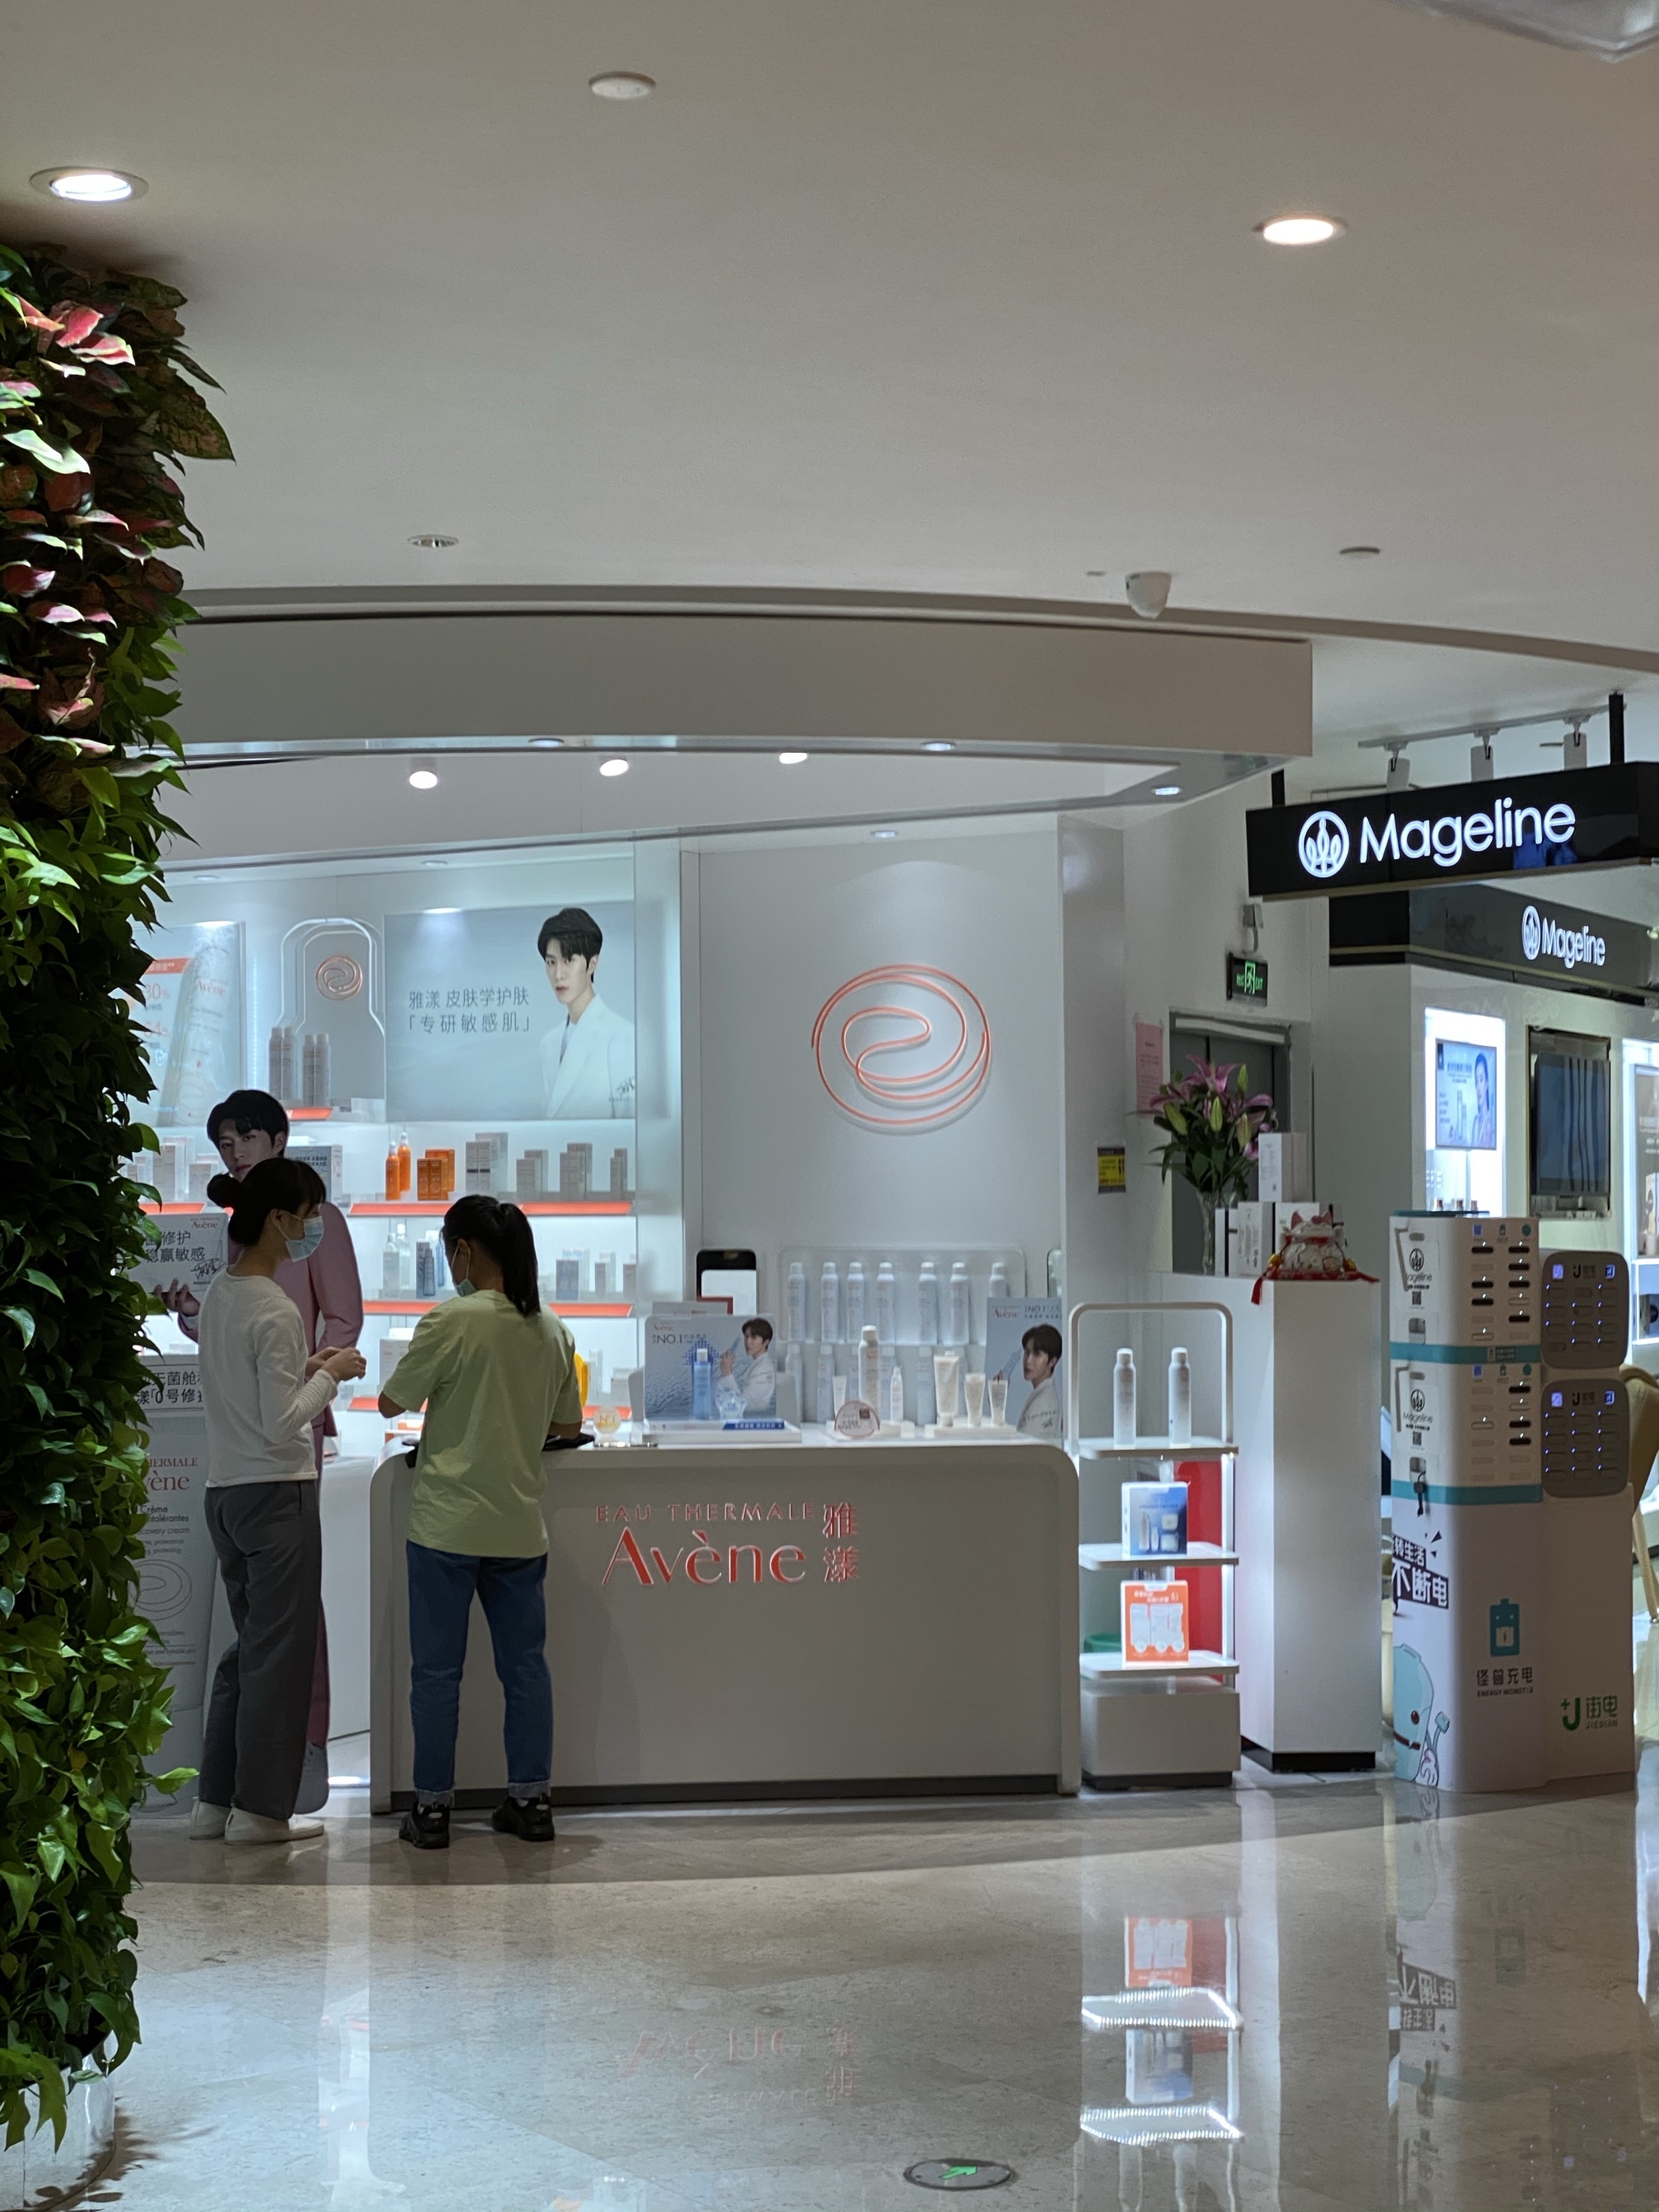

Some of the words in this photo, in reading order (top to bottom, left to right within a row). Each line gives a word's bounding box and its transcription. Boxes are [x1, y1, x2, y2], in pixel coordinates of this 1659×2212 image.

[1359, 797, 1576, 867] Mageline
[1541, 917, 1606, 969] Mageline
[408, 989, 440, 1010] 雅漾
[446, 985, 529, 1009] 皮肤学护肤
[140, 1504, 169, 1513] Crème
[596, 1503, 651, 1522] EAU
[667, 1502, 815, 1522] THERMALE
[602, 1527, 806, 1585] Avène
[823, 1501, 860, 1582] 雅漾
[1391, 1556, 1448, 1607] 不断电
[1476, 1666, 1532, 1686] 怪兽充电
[1586, 1696, 1618, 1719] 街电
